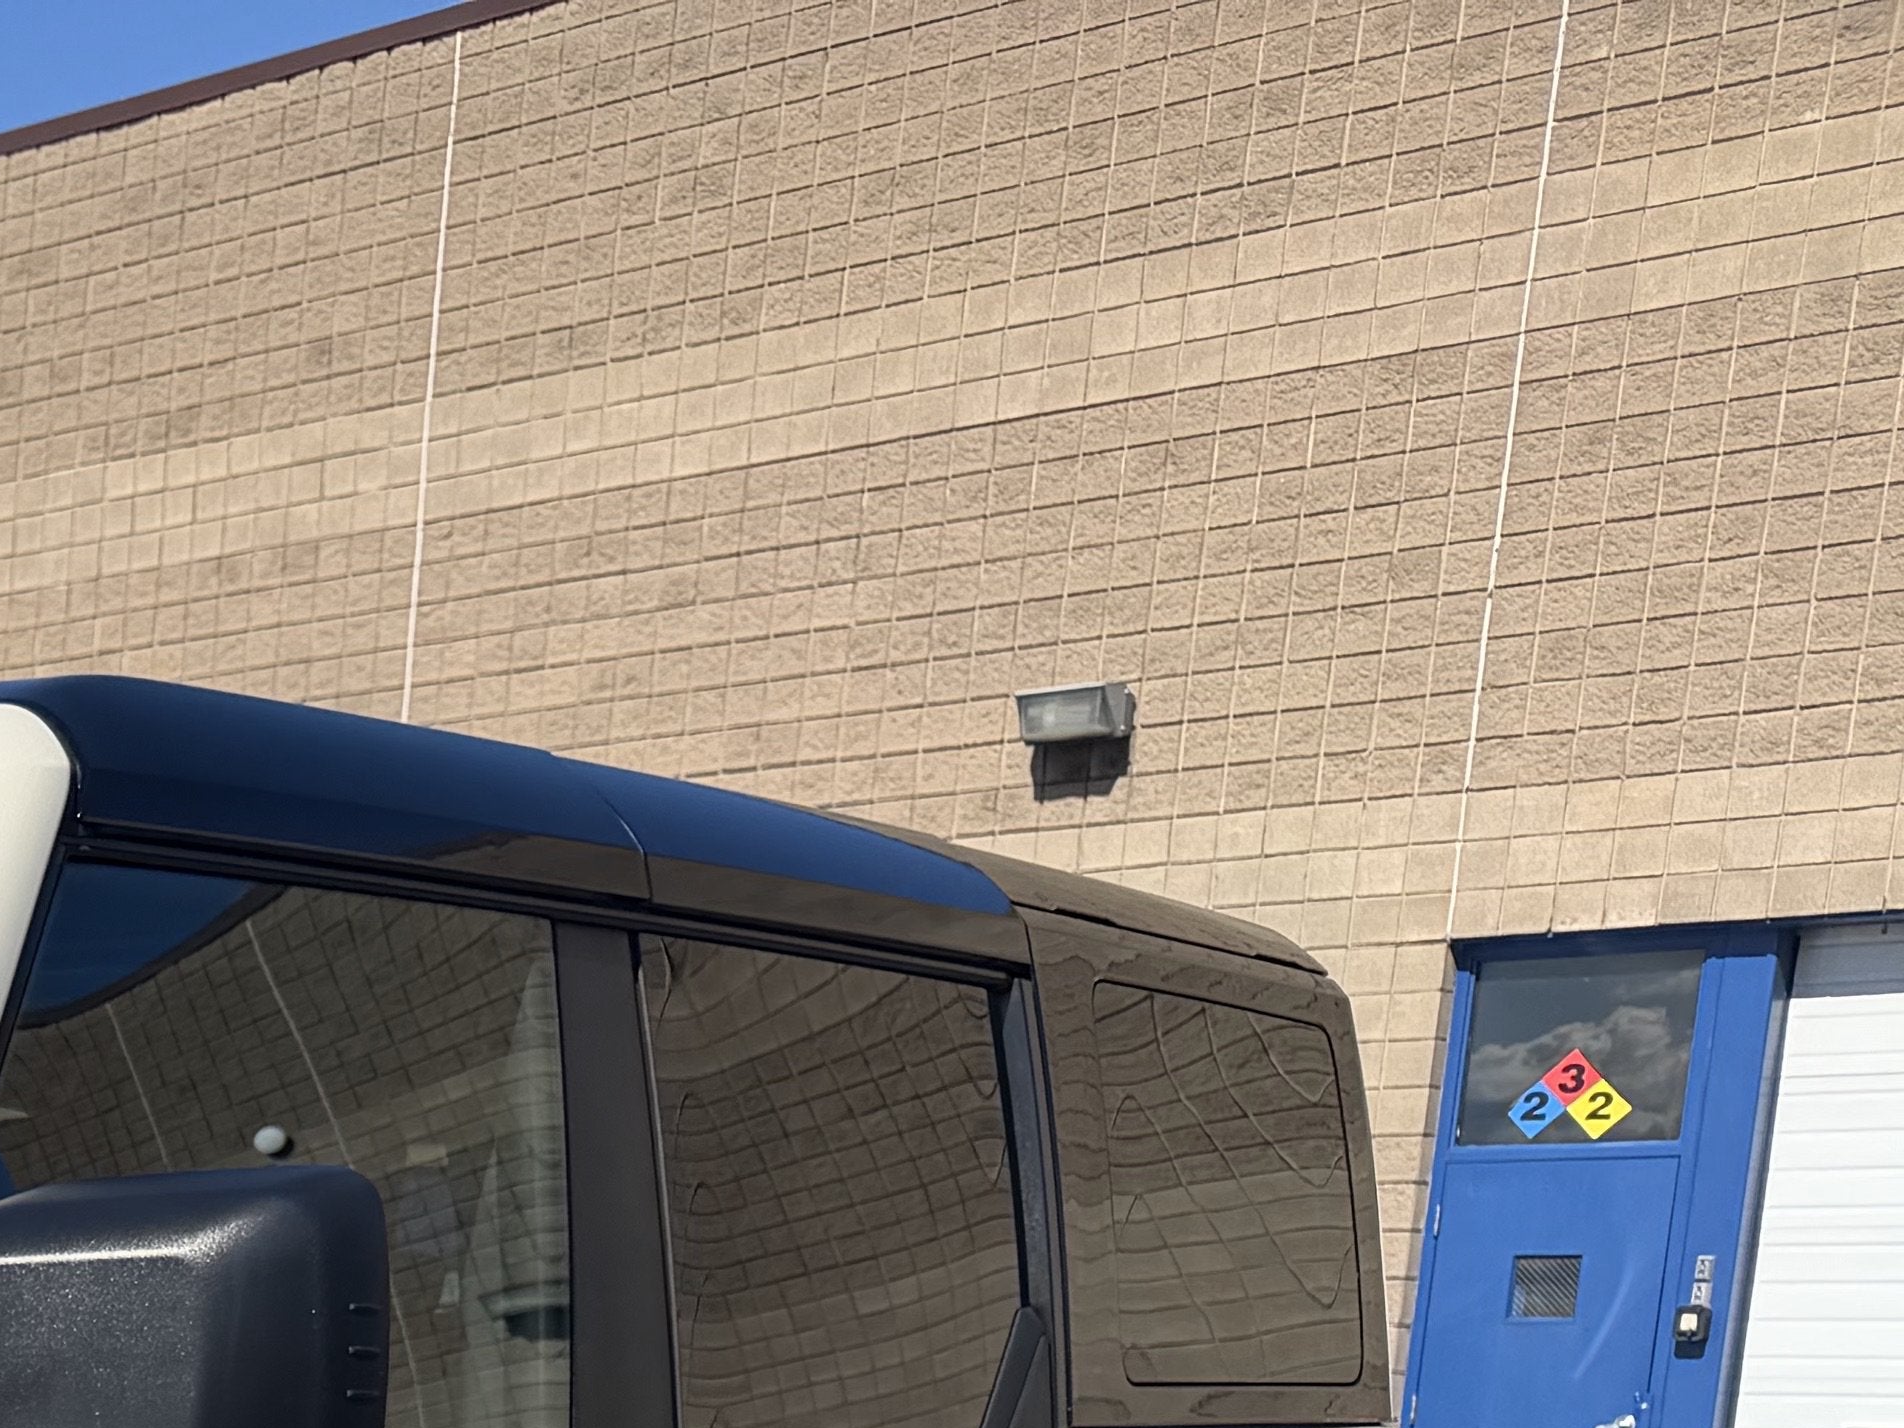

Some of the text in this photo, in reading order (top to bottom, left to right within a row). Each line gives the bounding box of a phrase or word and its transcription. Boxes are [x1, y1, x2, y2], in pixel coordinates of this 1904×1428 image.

[1558, 1063, 1586, 1094] 3
[1520, 1091, 1550, 1122] 2
[1585, 1091, 1614, 1121] 2
